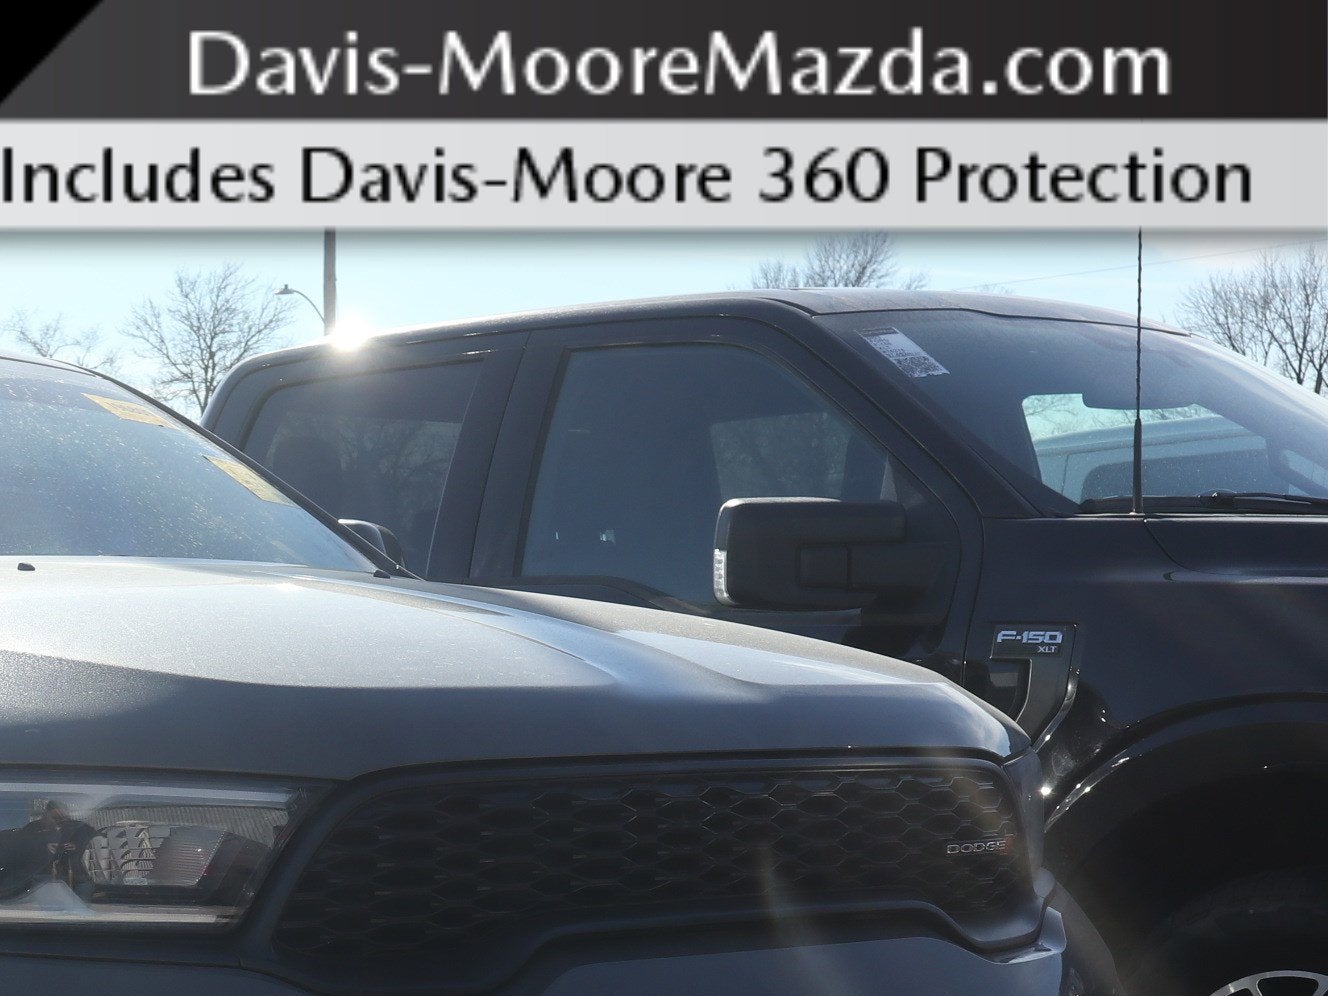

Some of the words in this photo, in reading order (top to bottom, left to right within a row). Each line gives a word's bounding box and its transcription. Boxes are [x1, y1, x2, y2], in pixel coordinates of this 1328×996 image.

[996, 630, 1063, 644] F-150
[1037, 645, 1058, 653] XLT
[946, 840, 1007, 854] DODGE
